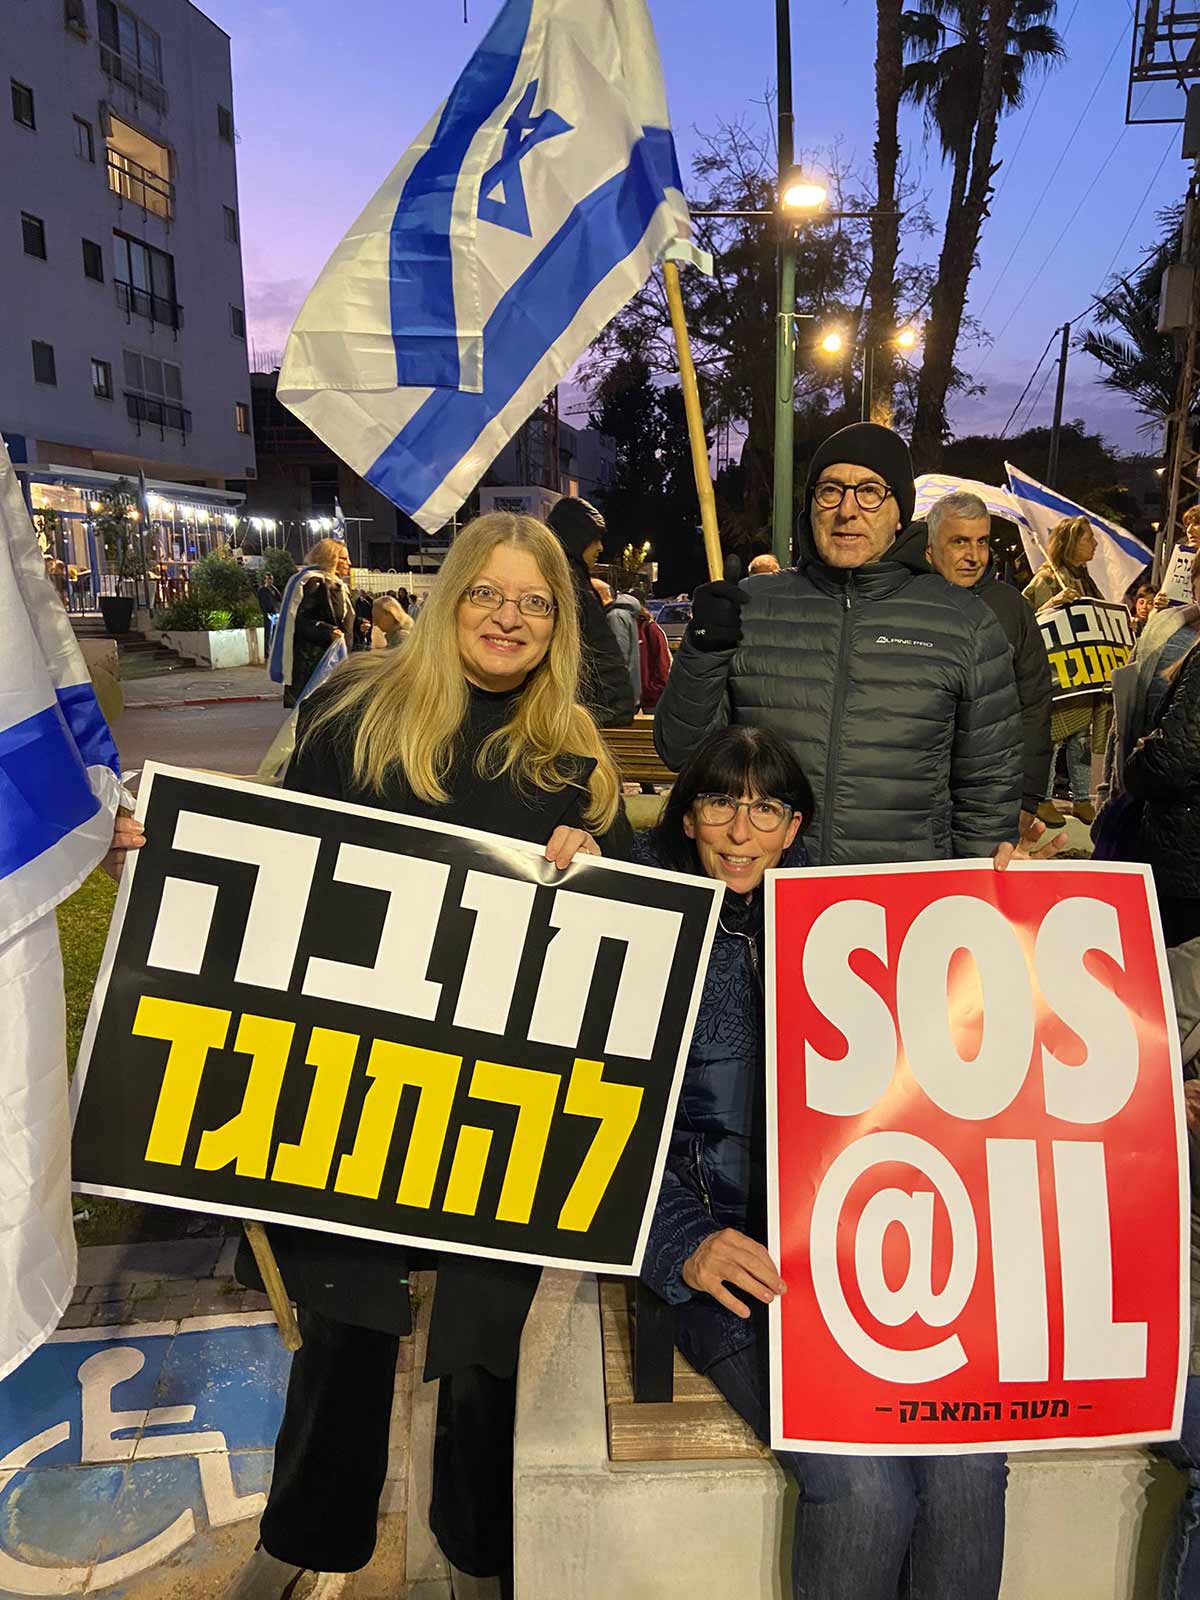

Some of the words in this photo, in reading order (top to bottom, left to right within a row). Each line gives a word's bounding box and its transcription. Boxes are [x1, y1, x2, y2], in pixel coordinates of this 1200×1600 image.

[913, 640, 933, 648] PRO
[1036, 604, 1133, 649] חובה
[1048, 645, 1134, 689] התנגד
[147, 809, 684, 1060] חובה
[802, 895, 1140, 1124] SOS
[131, 995, 645, 1233] להתנגד
[809, 1131, 1148, 1383] @IL
[899, 1400, 1001, 1423] המאבק
[1010, 1399, 1070, 1419] מטה
